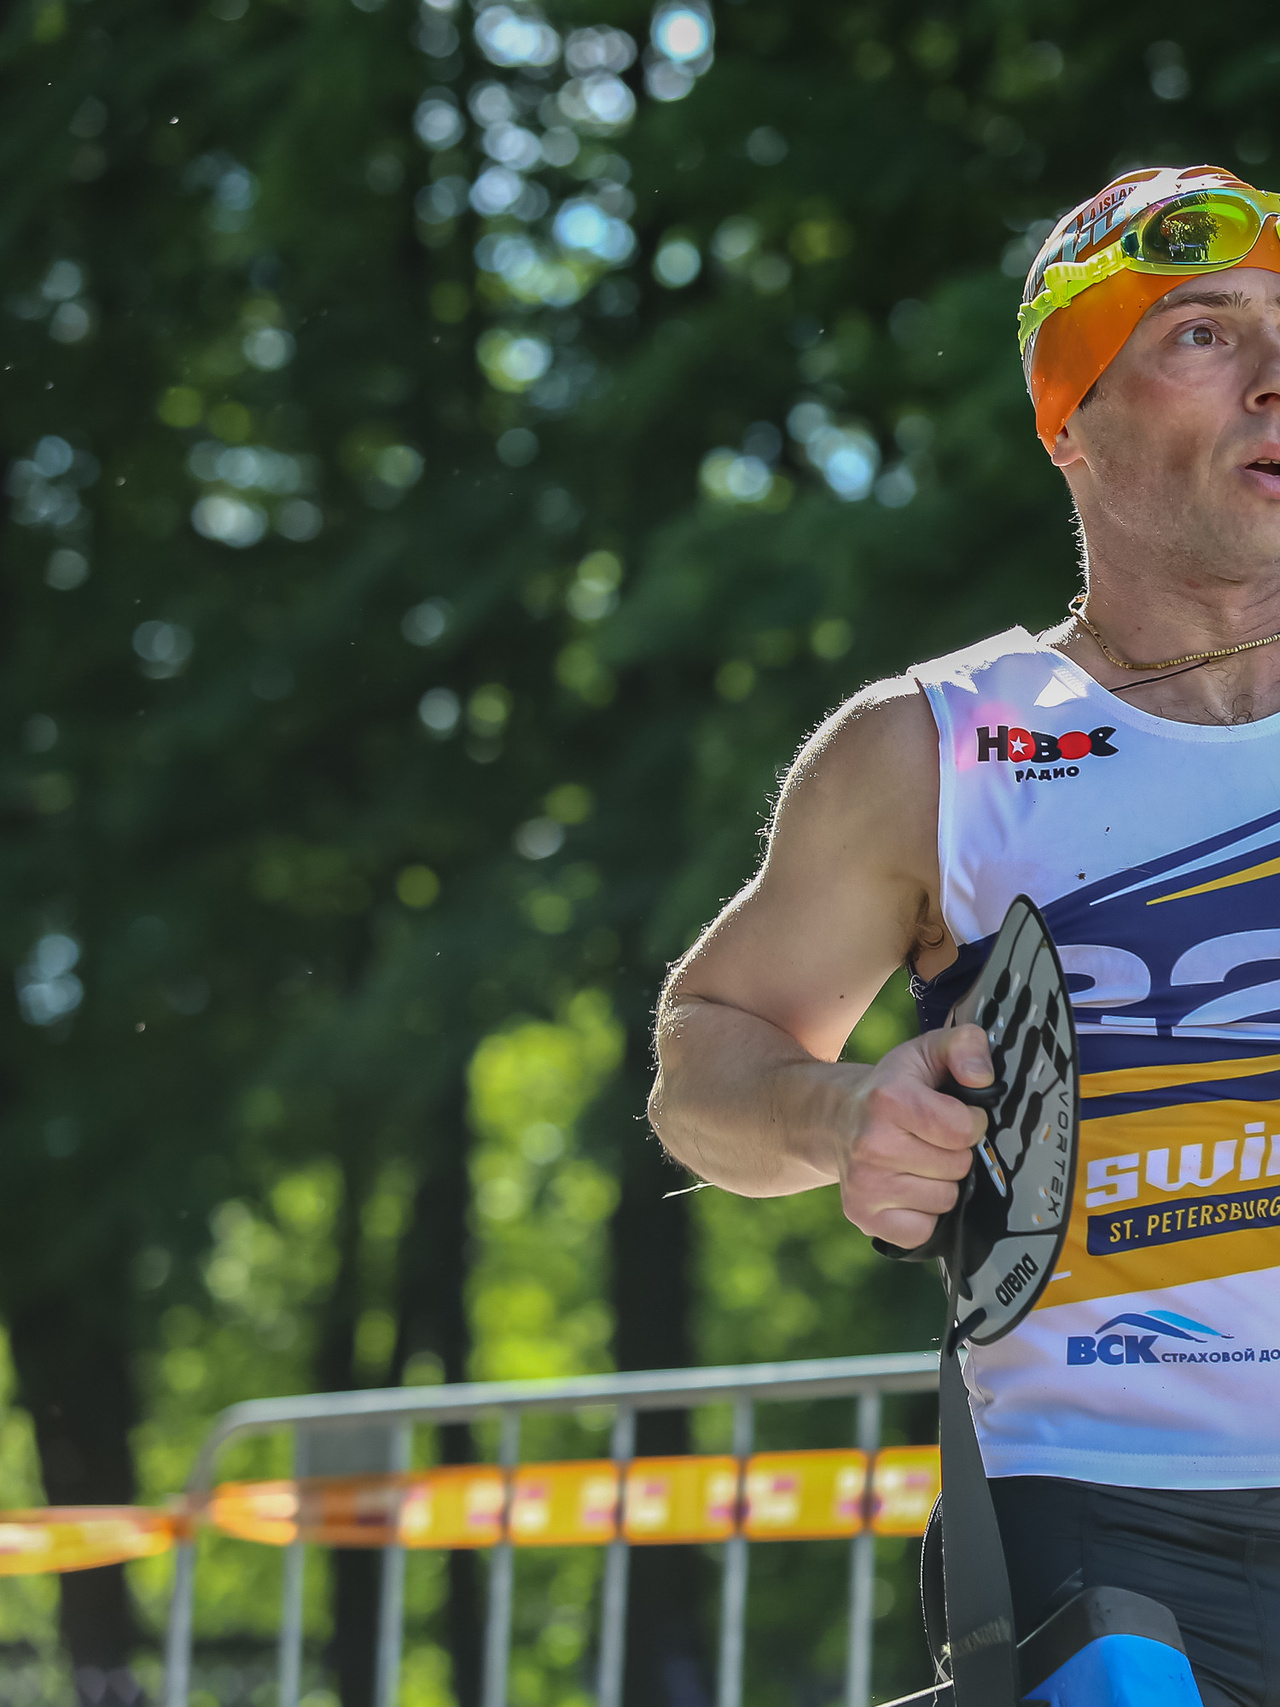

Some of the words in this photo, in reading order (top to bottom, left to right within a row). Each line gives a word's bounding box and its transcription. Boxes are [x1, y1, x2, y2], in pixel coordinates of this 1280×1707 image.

[1046, 1091, 1069, 1219] VORTEX
[1109, 1219, 1139, 1243] ST.
[995, 1253, 1039, 1307] arena
[1067, 1334, 1160, 1365] ВСК
[1161, 1348, 1255, 1363] СТРАХОВОЙ
